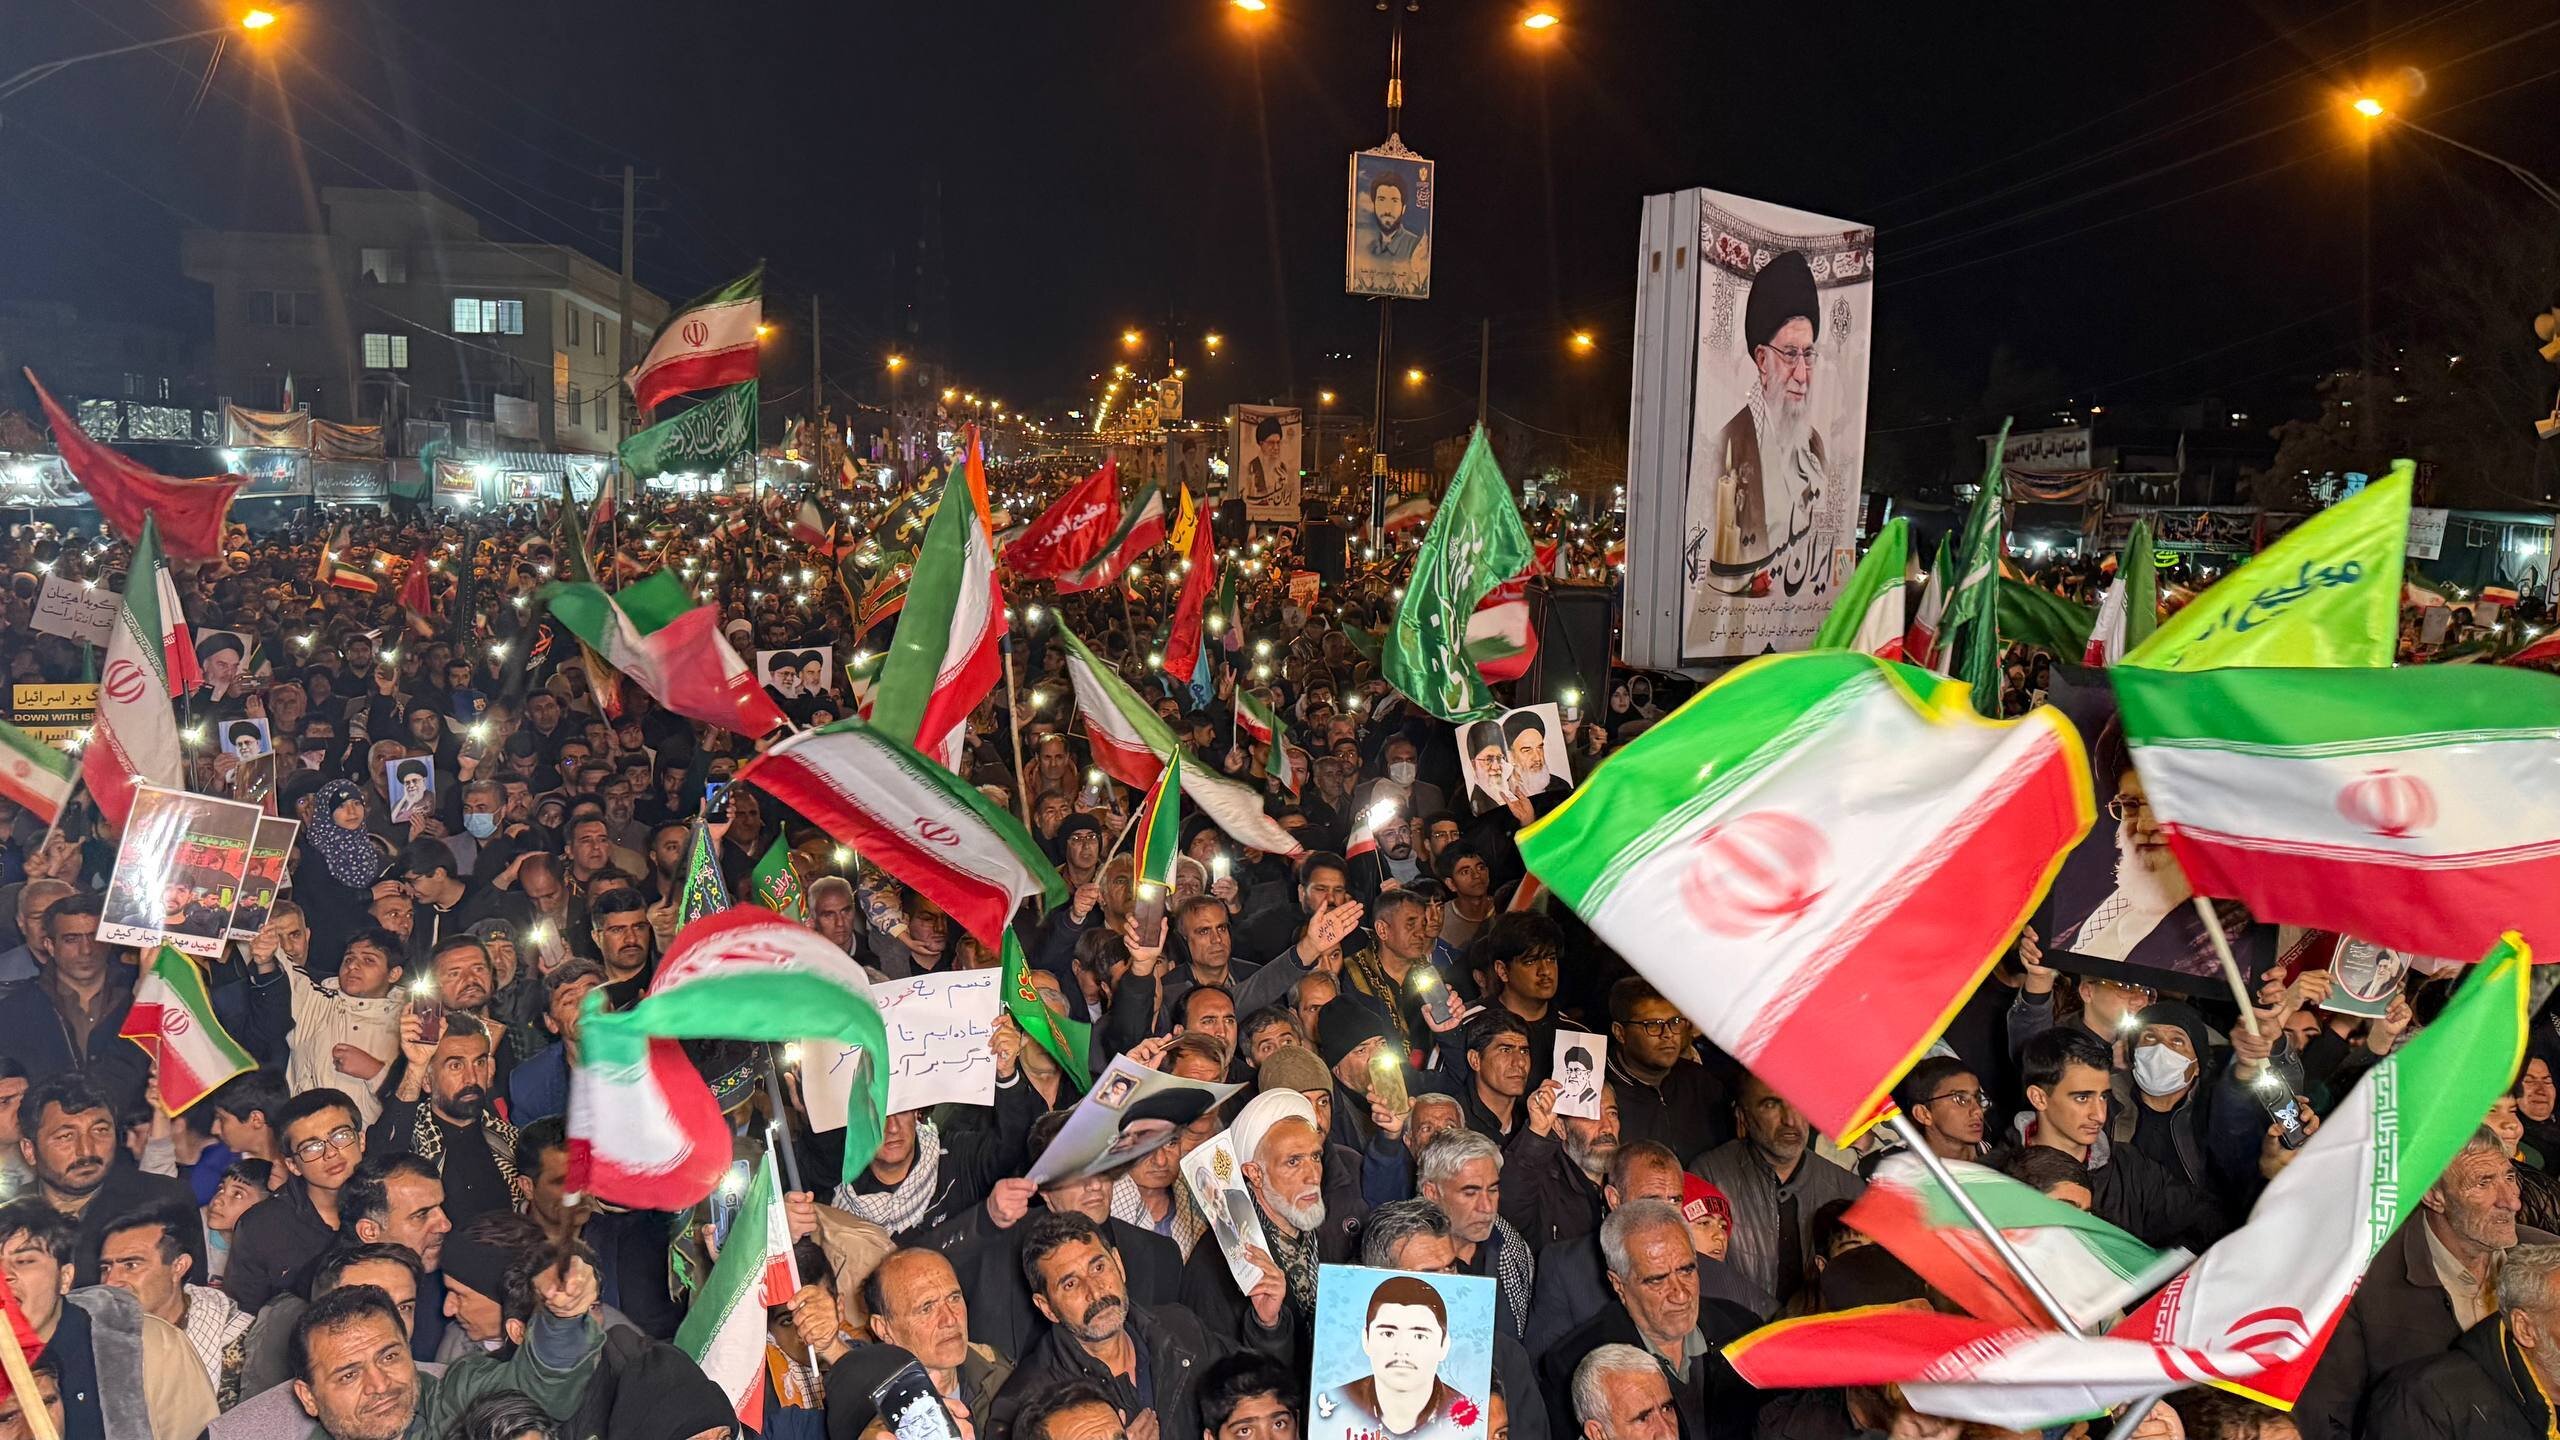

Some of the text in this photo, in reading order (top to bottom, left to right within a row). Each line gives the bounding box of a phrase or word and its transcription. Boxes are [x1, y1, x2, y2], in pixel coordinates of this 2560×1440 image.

[1784, 534, 1834, 597] ایران
[17, 690, 65, 707] اسرائیل
[14, 714, 49, 722] DOWN
[52, 713, 78, 721] WITH
[191, 941, 217, 952] شهید
[879, 987, 916, 1009] خون
[948, 976, 992, 1008] قسم
[915, 1059, 939, 1076] بر
[943, 1047, 991, 1073] مرگ
